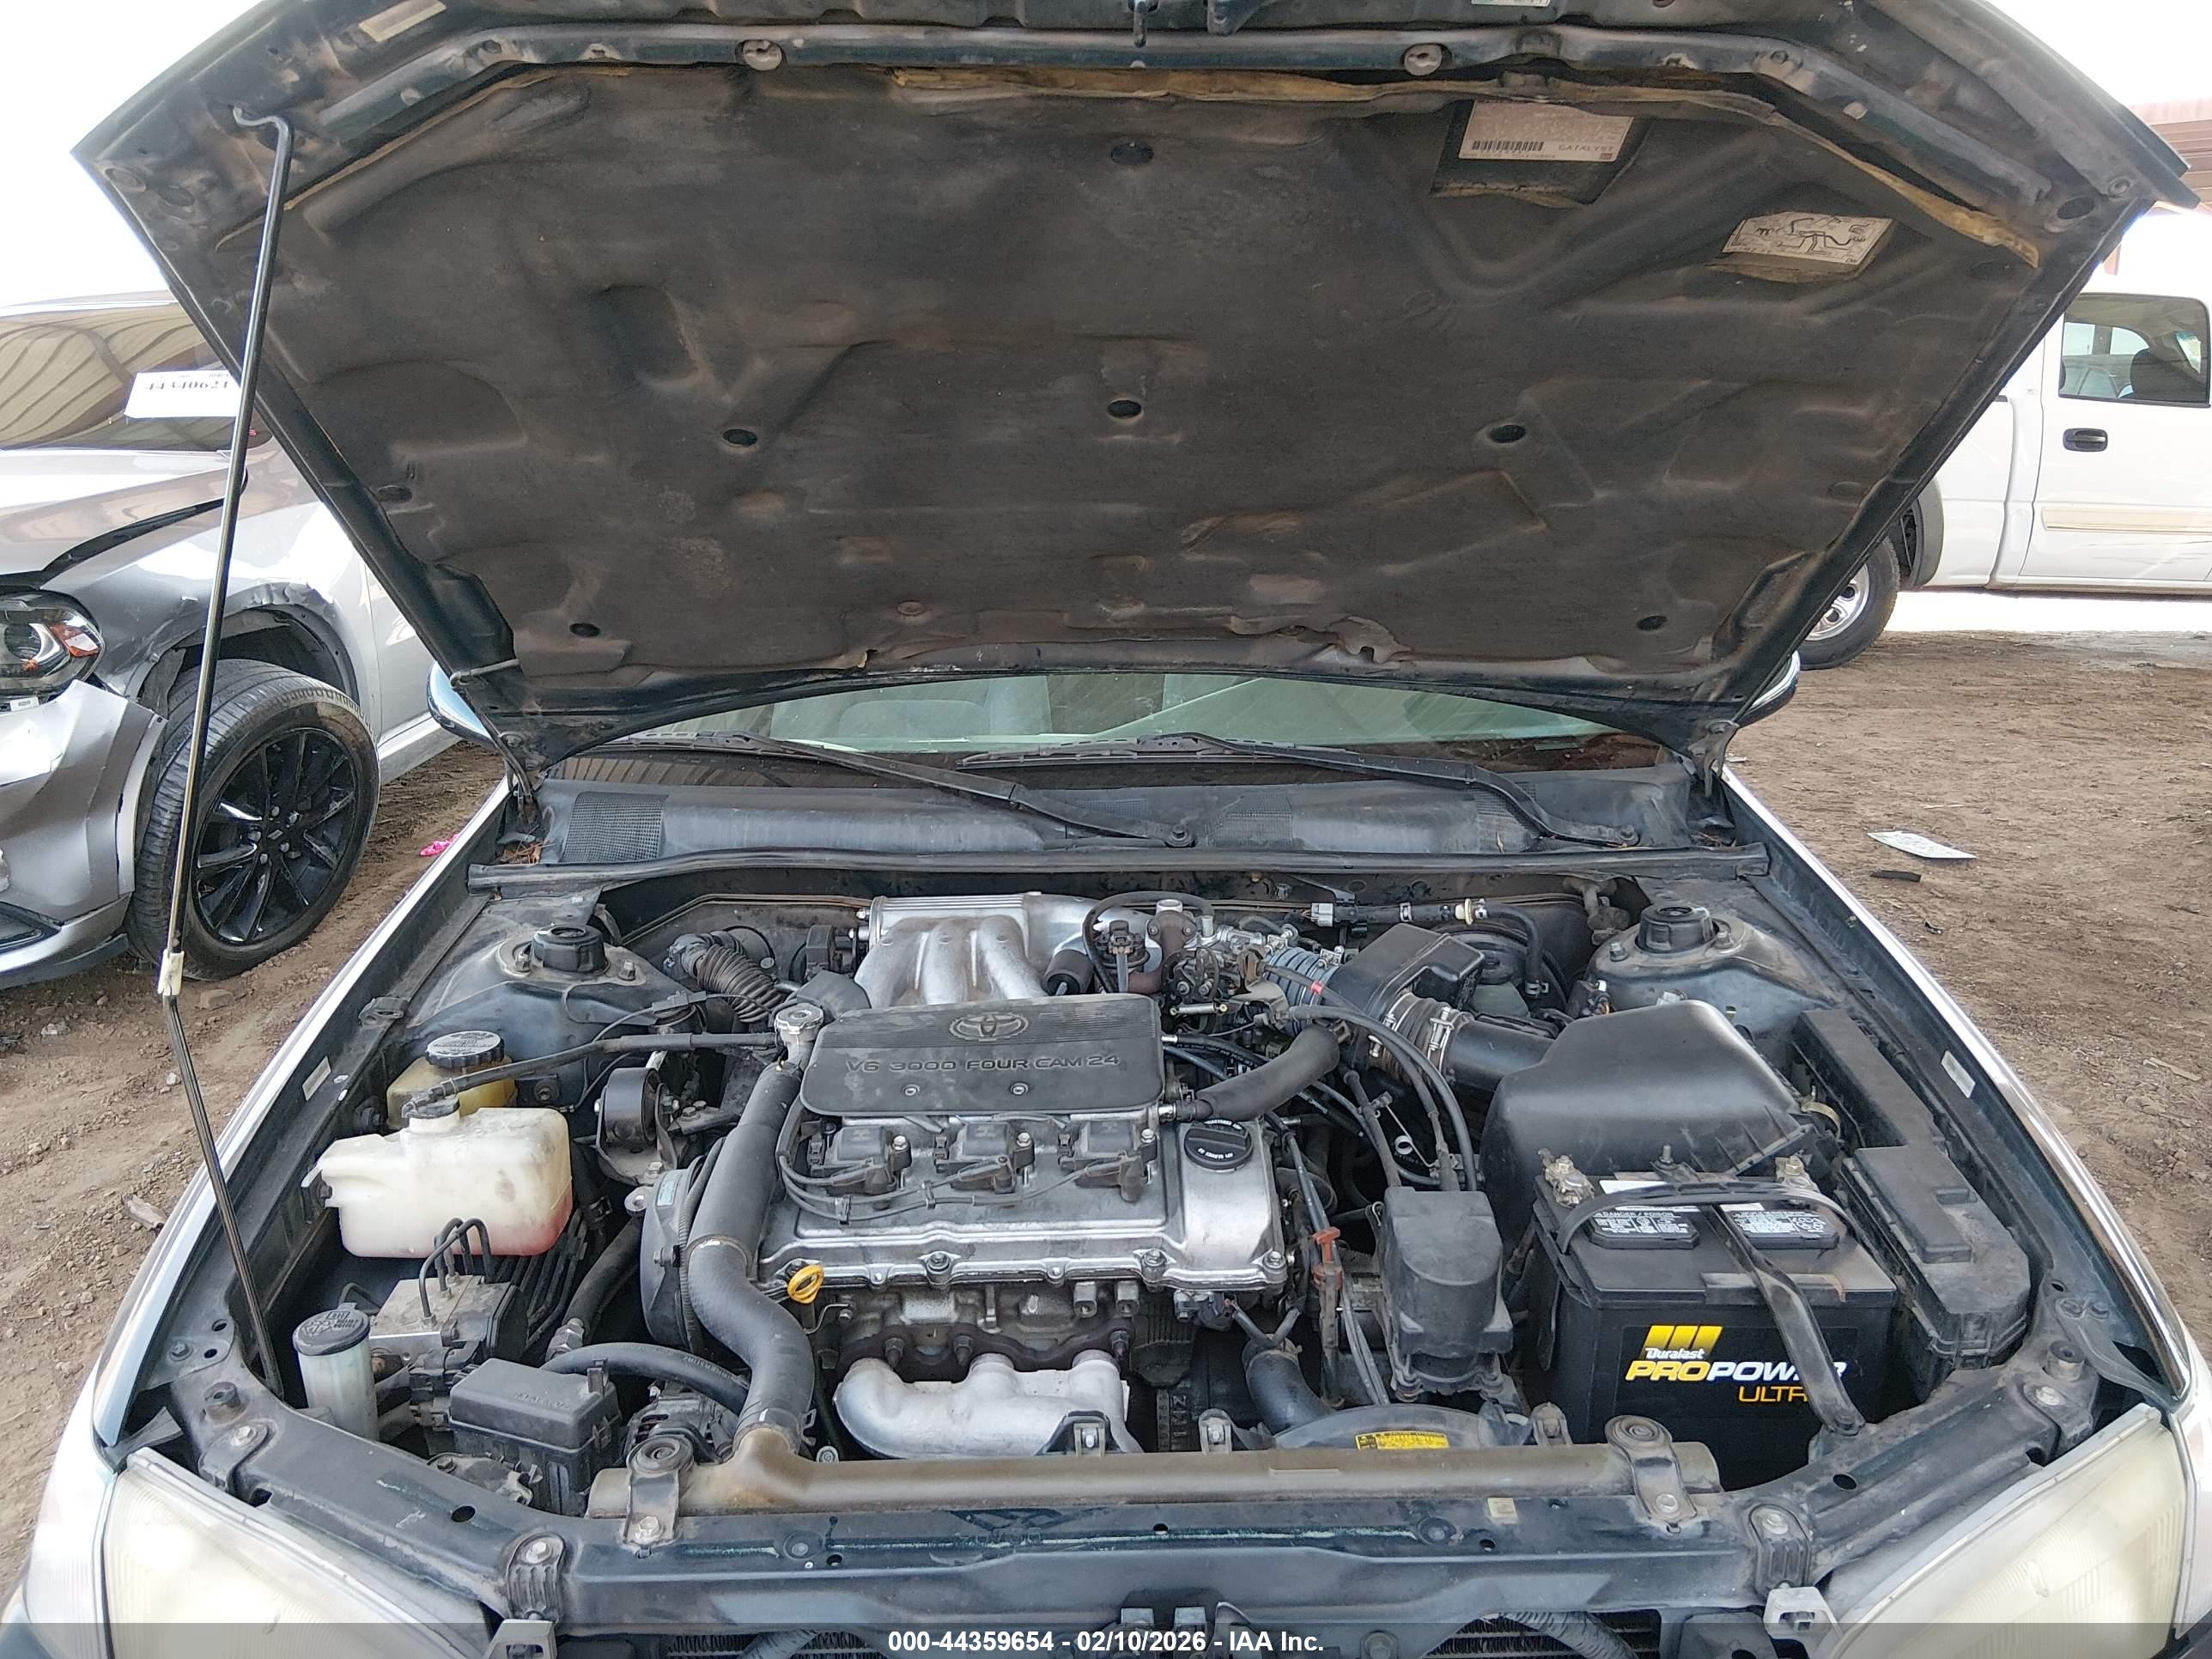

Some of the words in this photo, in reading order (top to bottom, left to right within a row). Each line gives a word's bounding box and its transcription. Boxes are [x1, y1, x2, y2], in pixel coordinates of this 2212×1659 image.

[846, 1060, 880, 1073] V6
[890, 1060, 957, 1072] 3000
[965, 1057, 1029, 1071] FOUR
[1034, 1055, 1083, 1069] CAM
[1085, 1054, 1120, 1066] 24
[1644, 1347, 1705, 1359] Duralast
[1737, 1385, 1808, 1402] ULTR
